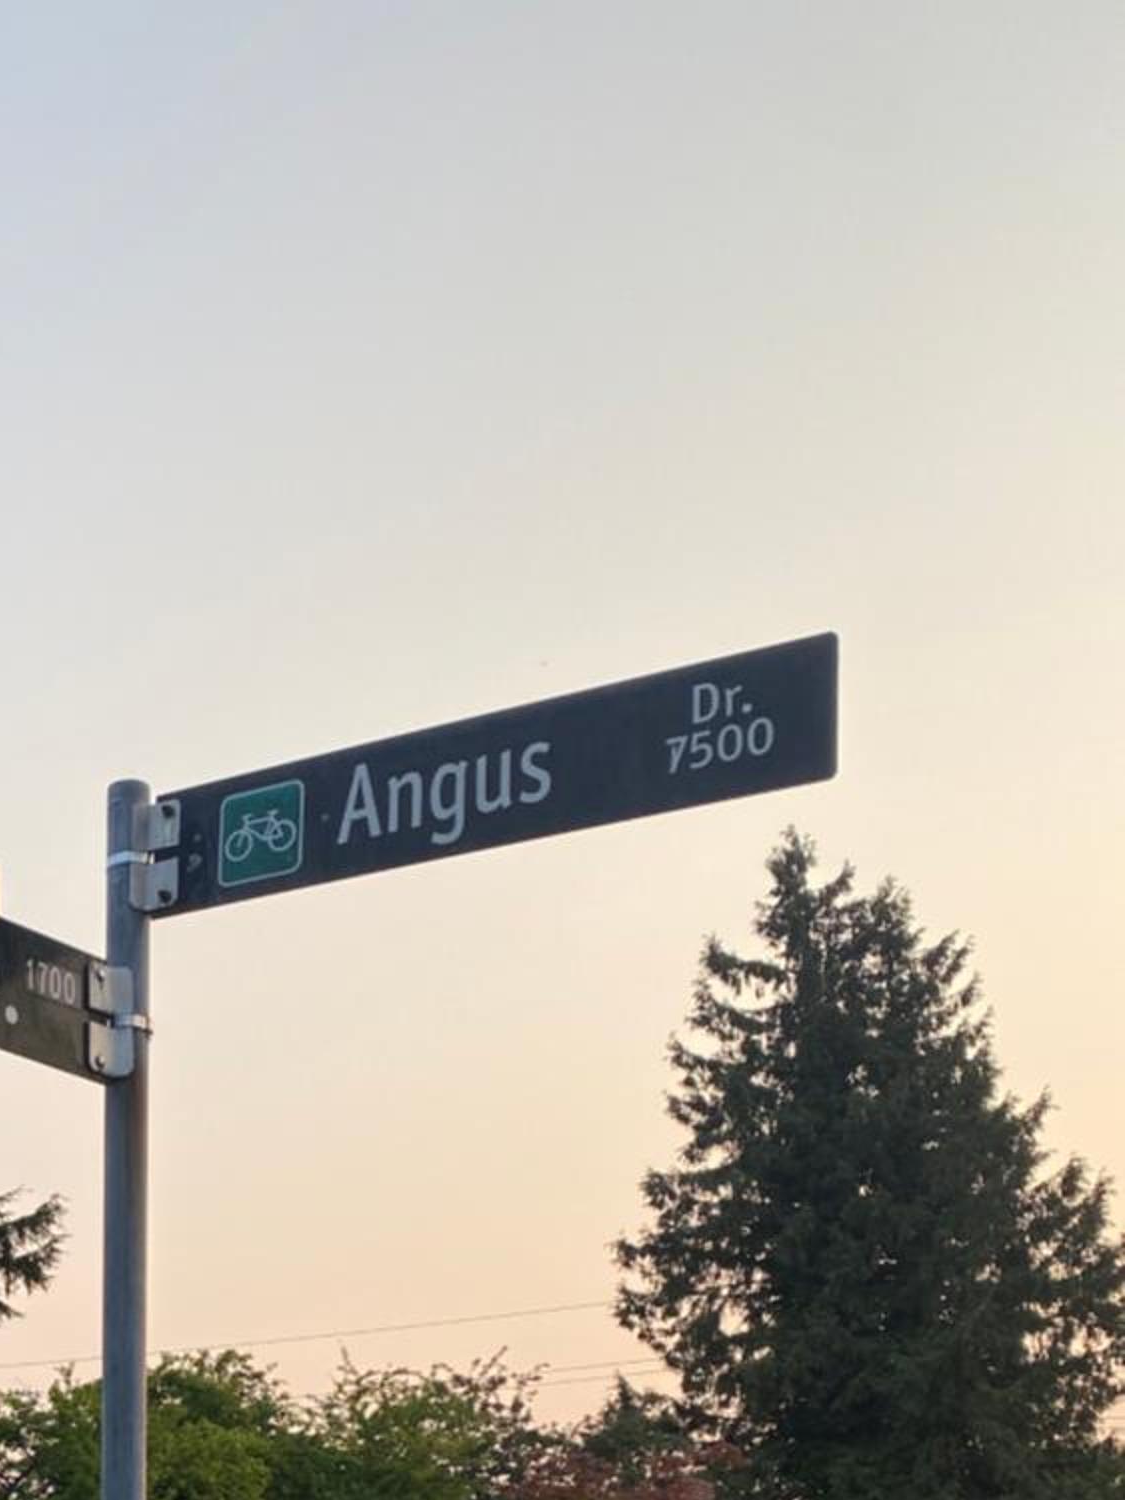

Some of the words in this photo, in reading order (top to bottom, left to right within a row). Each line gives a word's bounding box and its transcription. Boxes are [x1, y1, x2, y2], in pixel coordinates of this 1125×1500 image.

[691, 681, 754, 725] Dr.
[666, 716, 774, 774] 7500
[336, 742, 552, 845] Angus
[27, 959, 75, 1005] 1700
